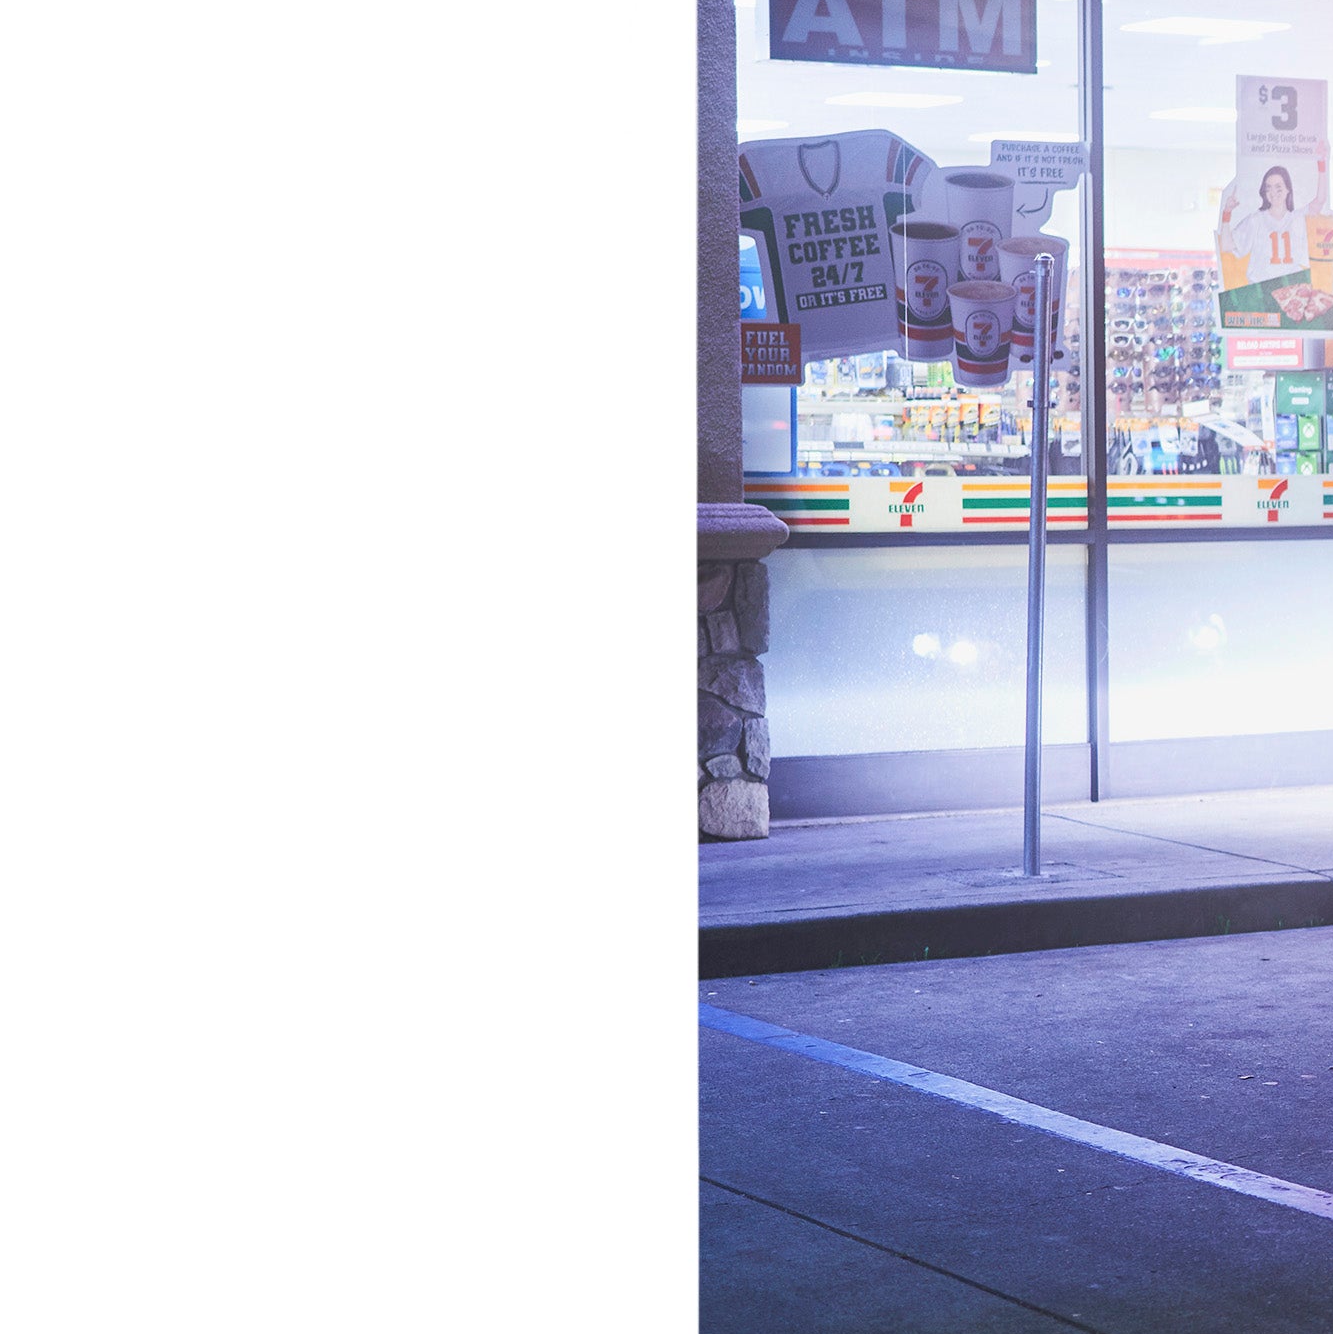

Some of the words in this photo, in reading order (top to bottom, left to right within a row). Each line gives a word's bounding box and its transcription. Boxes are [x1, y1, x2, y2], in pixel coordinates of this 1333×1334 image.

[1258, 85, 1298, 130] $3
[996, 154, 1013, 163] AND
[1042, 156, 1056, 165] NOT
[1043, 145, 1050, 153] A
[1051, 145, 1080, 155] COFFEE
[1040, 169, 1064, 179] FREE
[783, 205, 877, 239] FRESH
[788, 233, 881, 265] COFFEE
[811, 261, 864, 288] 24/7
[799, 295, 818, 309] OR
[820, 290, 847, 306] IT'S
[849, 286, 885, 302] FREE
[745, 331, 790, 346] FUEL
[744, 347, 791, 362] YOUR
